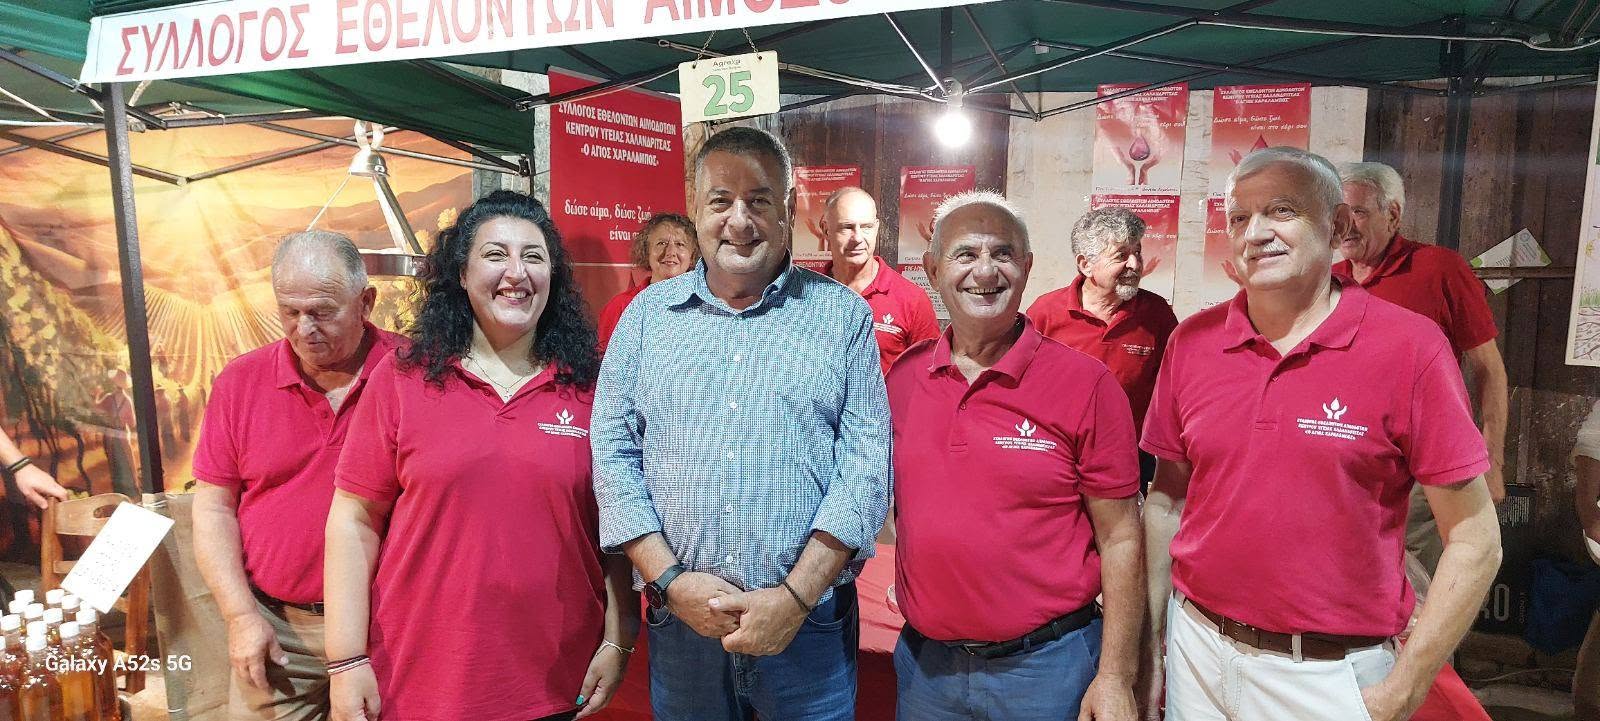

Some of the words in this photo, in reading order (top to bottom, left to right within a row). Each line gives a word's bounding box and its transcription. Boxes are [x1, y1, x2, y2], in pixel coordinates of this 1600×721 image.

[116, 4, 309, 75] ΣΥΛΛΟΓΟΣ
[702, 71, 754, 116] 25
[559, 101, 596, 119] ΣΥΛΛΟΓΟΣ
[597, 108, 638, 128] ΕΘΕΛΟΝΤΩΝ
[639, 117, 676, 135] ΑΙΜΟΔΟΤΩΝ
[565, 121, 600, 138] ΚΕΝΤΡΟΥ
[600, 127, 624, 143] ΥΓΕΙΑΣ
[625, 131, 671, 151] ΧΑΛΑΝΔΡΙΤΣΑΣ
[590, 144, 612, 159] ΑΓΙΟΣ
[565, 199, 588, 215] δώσε
[590, 201, 612, 220] αίμα,
[615, 203, 636, 220] δώσε
[609, 225, 630, 241] είναι
